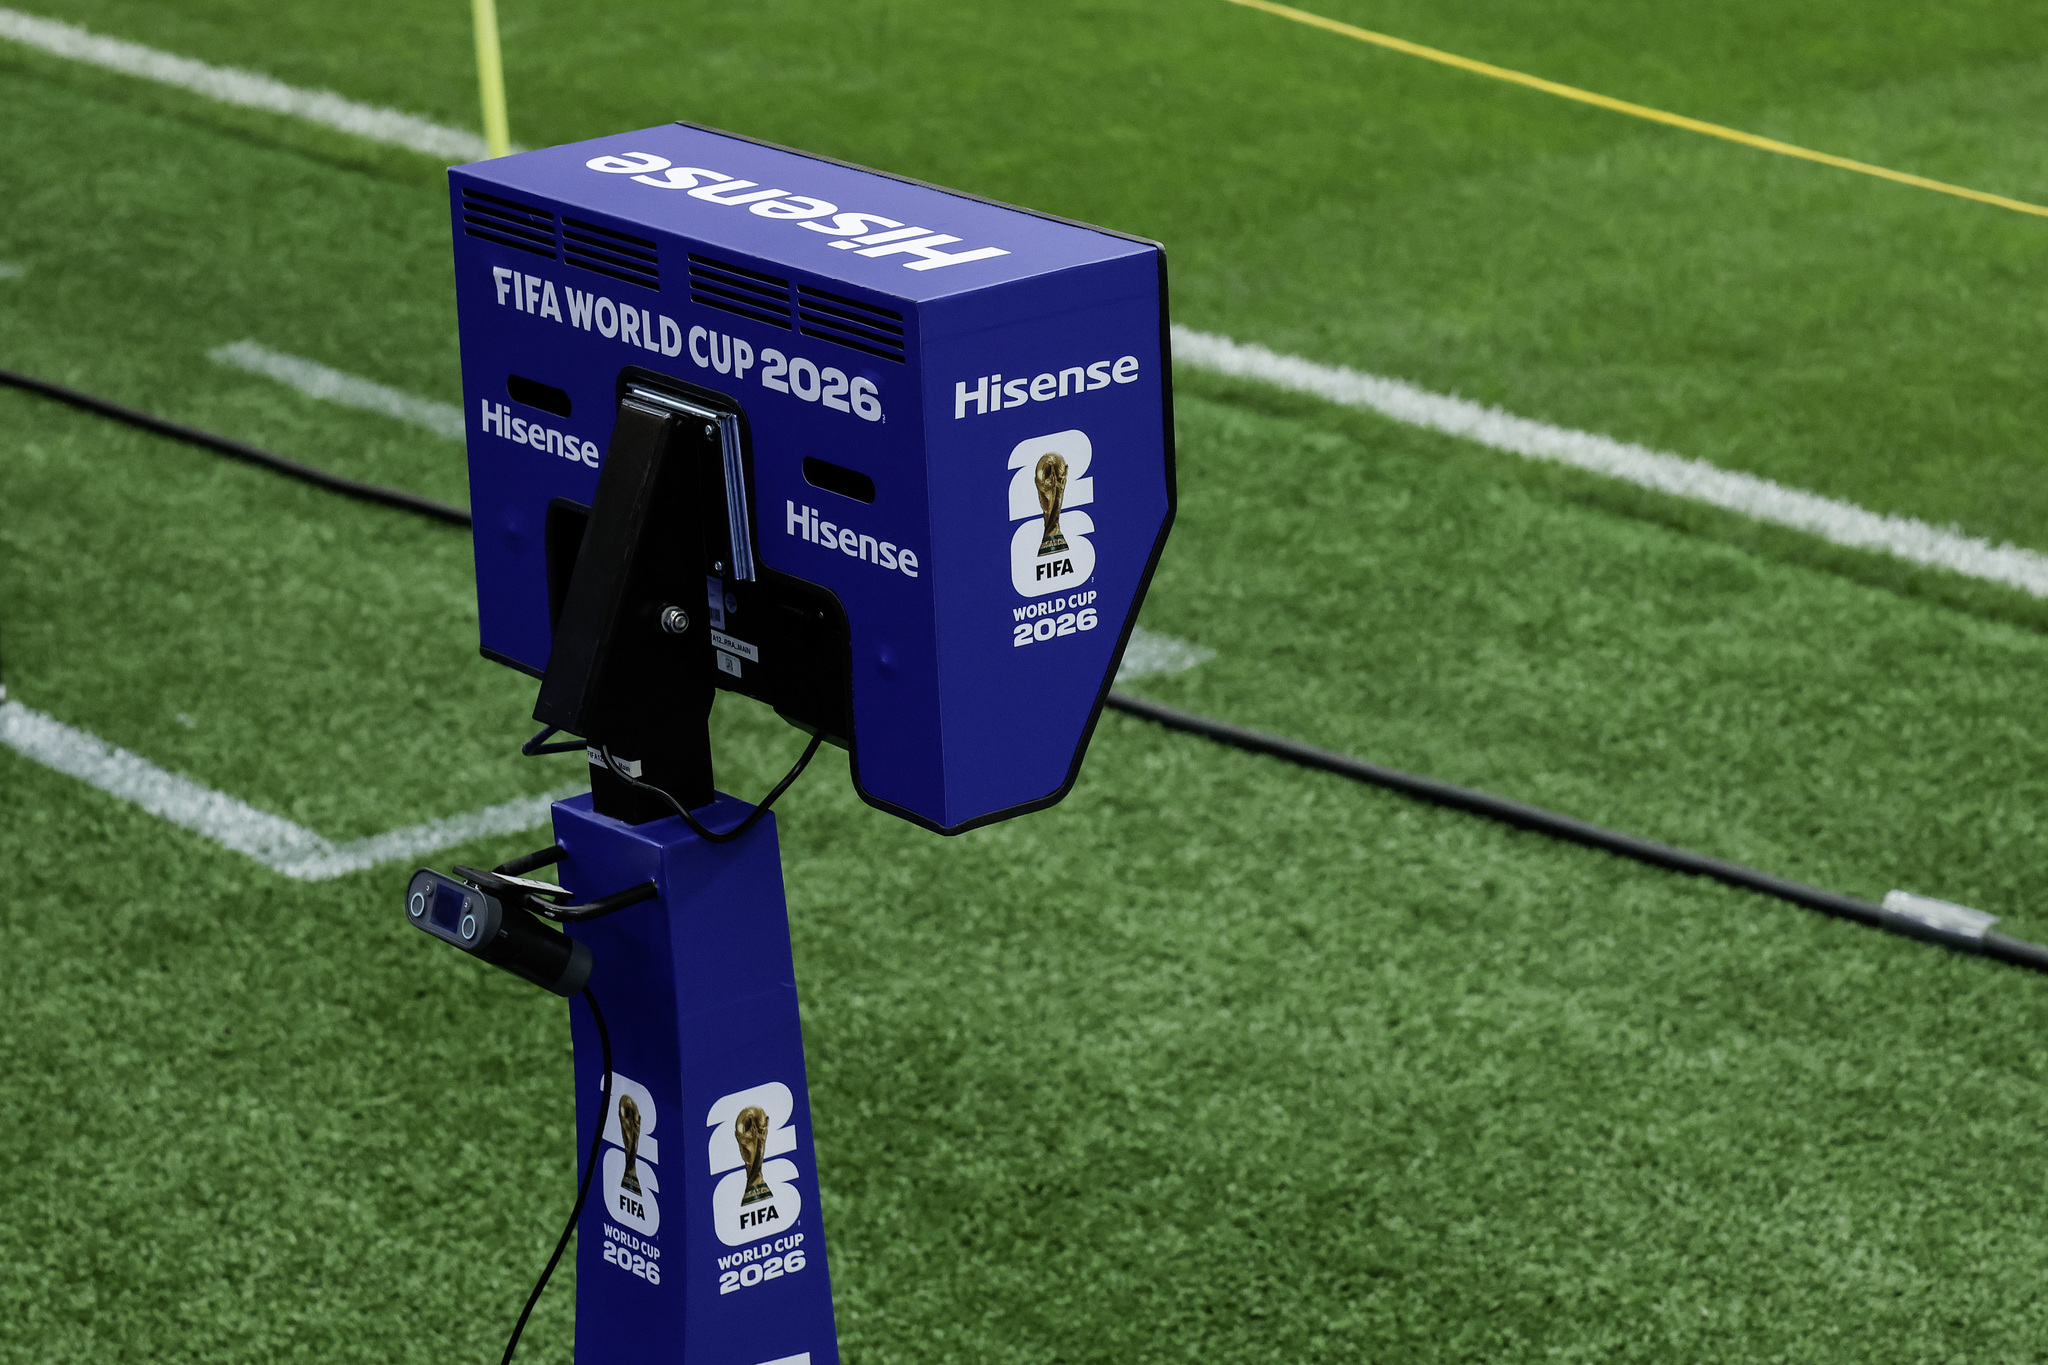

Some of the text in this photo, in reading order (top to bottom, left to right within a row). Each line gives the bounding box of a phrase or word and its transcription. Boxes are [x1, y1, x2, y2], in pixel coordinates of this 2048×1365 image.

[585, 151, 1012, 272] Hisense
[493, 265, 563, 324] FIFA
[565, 285, 683, 358] WORLD
[689, 325, 755, 380] CUP
[761, 347, 882, 422] 2026
[954, 355, 1140, 420] Hisense
[481, 398, 600, 469] Hisense
[786, 499, 919, 578] Hisense
[1036, 558, 1074, 582] FIFA
[1012, 590, 1098, 622] WORLD CUP
[1013, 607, 1098, 648] 2026
[619, 1194, 646, 1221] FIFA
[739, 1205, 779, 1230] FIFA
[603, 1222, 661, 1261] WORLD CUP
[603, 1240, 661, 1286] 2026
[717, 1232, 805, 1271] WORLD CUP
[718, 1249, 807, 1296] 2026
